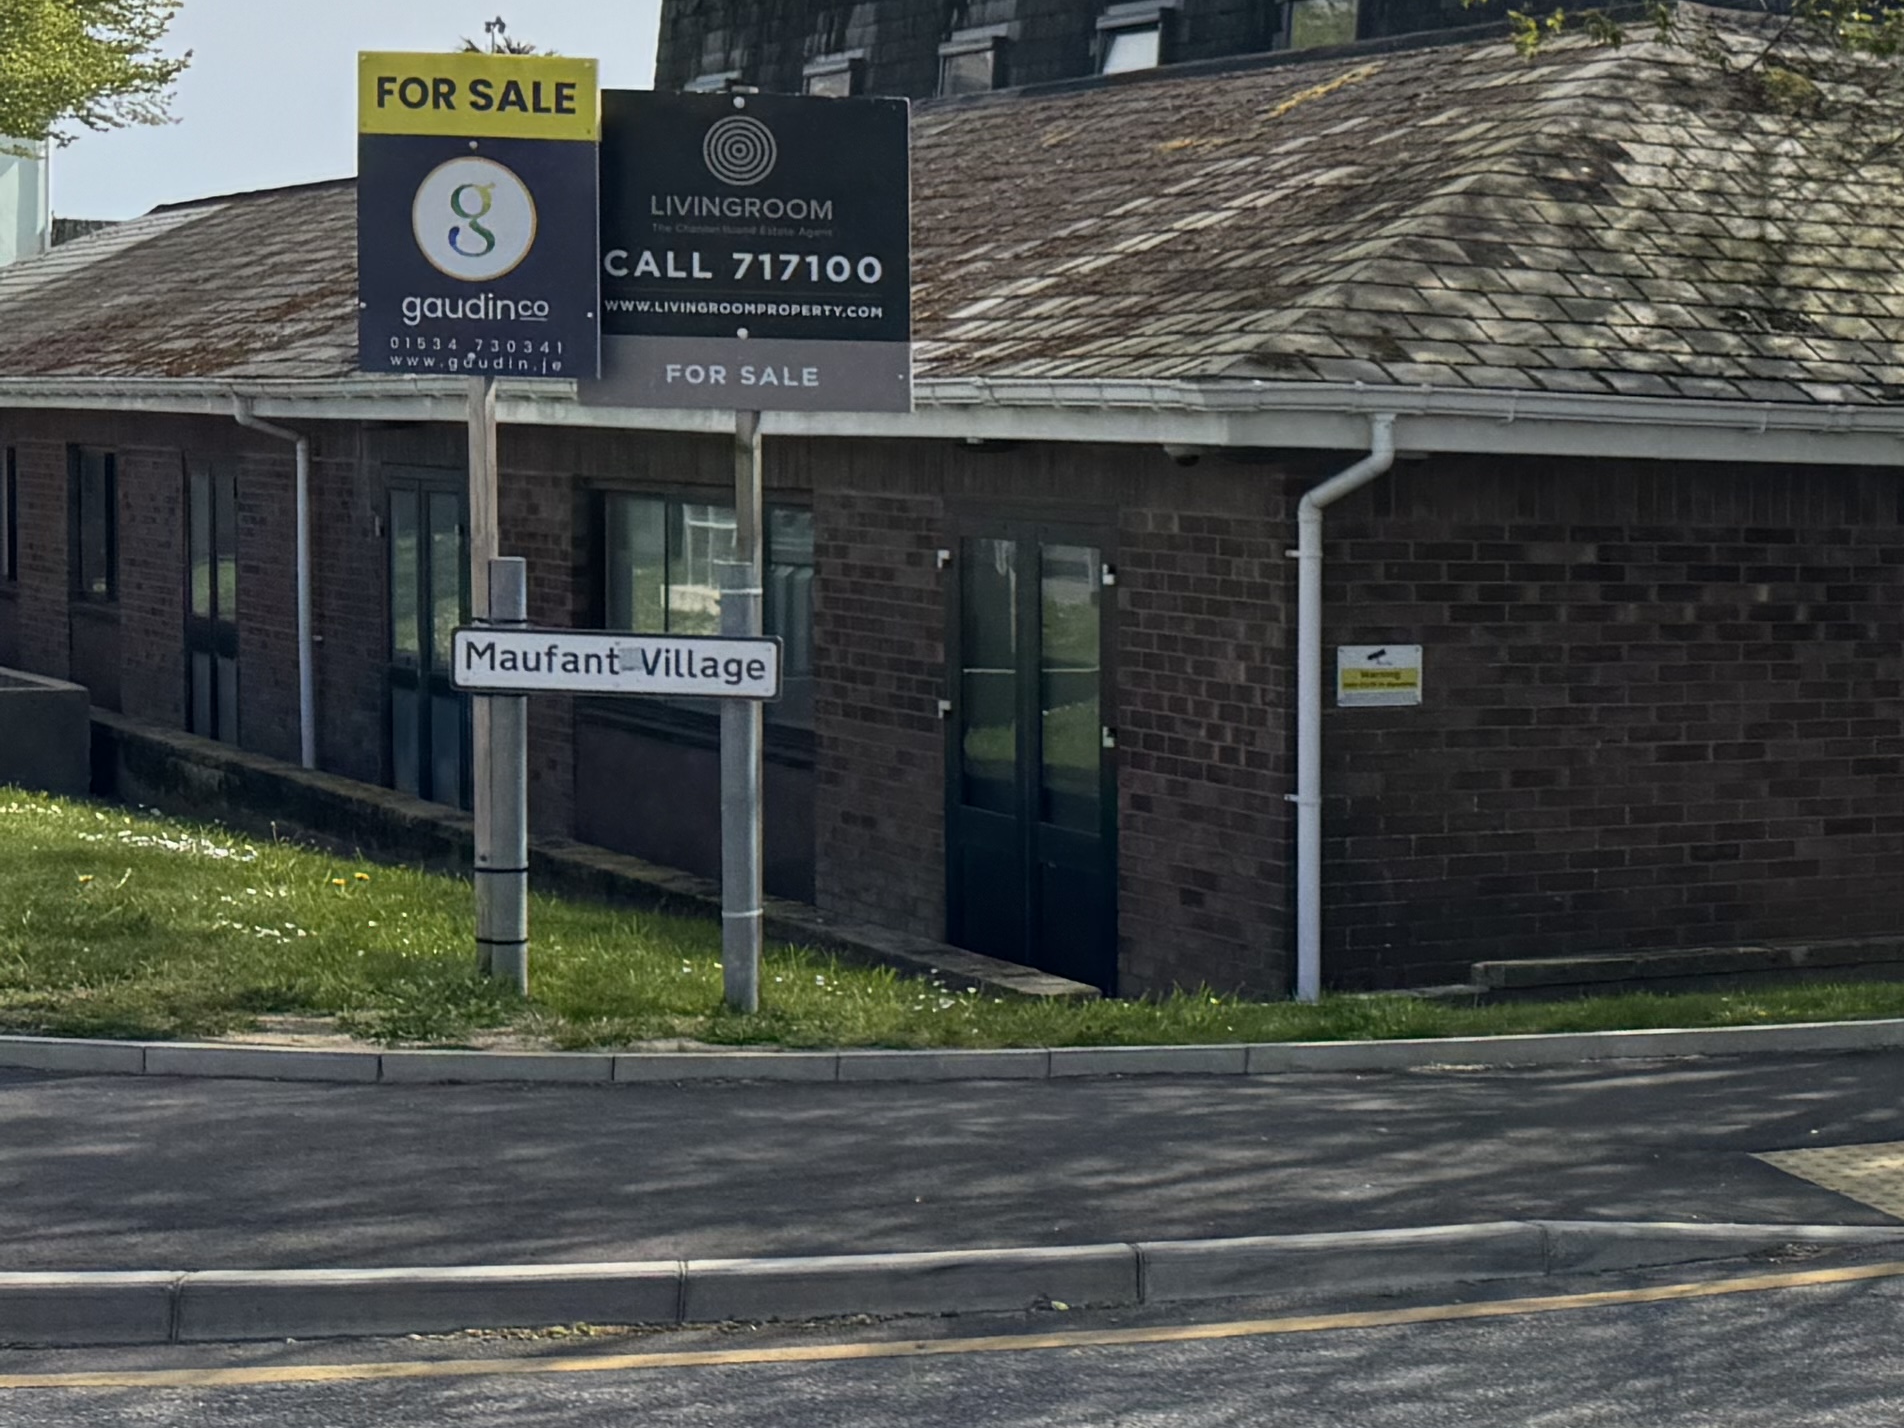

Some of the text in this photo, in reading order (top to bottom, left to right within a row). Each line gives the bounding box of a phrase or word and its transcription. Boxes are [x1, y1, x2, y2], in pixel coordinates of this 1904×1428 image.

[377, 76, 577, 115] FOR SALE
[650, 194, 833, 221] LIVINGROOM
[652, 223, 672, 234] The
[759, 226, 795, 237] Estate
[798, 227, 833, 239] Agent
[604, 249, 883, 284] CALL 717100
[604, 299, 883, 318] WWW.LIVINGROOMPROPERTY.COM
[390, 336, 563, 354] 01534 730341
[390, 355, 562, 375] www.gaudin.je
[666, 363, 819, 388] FOR SALE
[465, 641, 766, 685] Maufant Village
